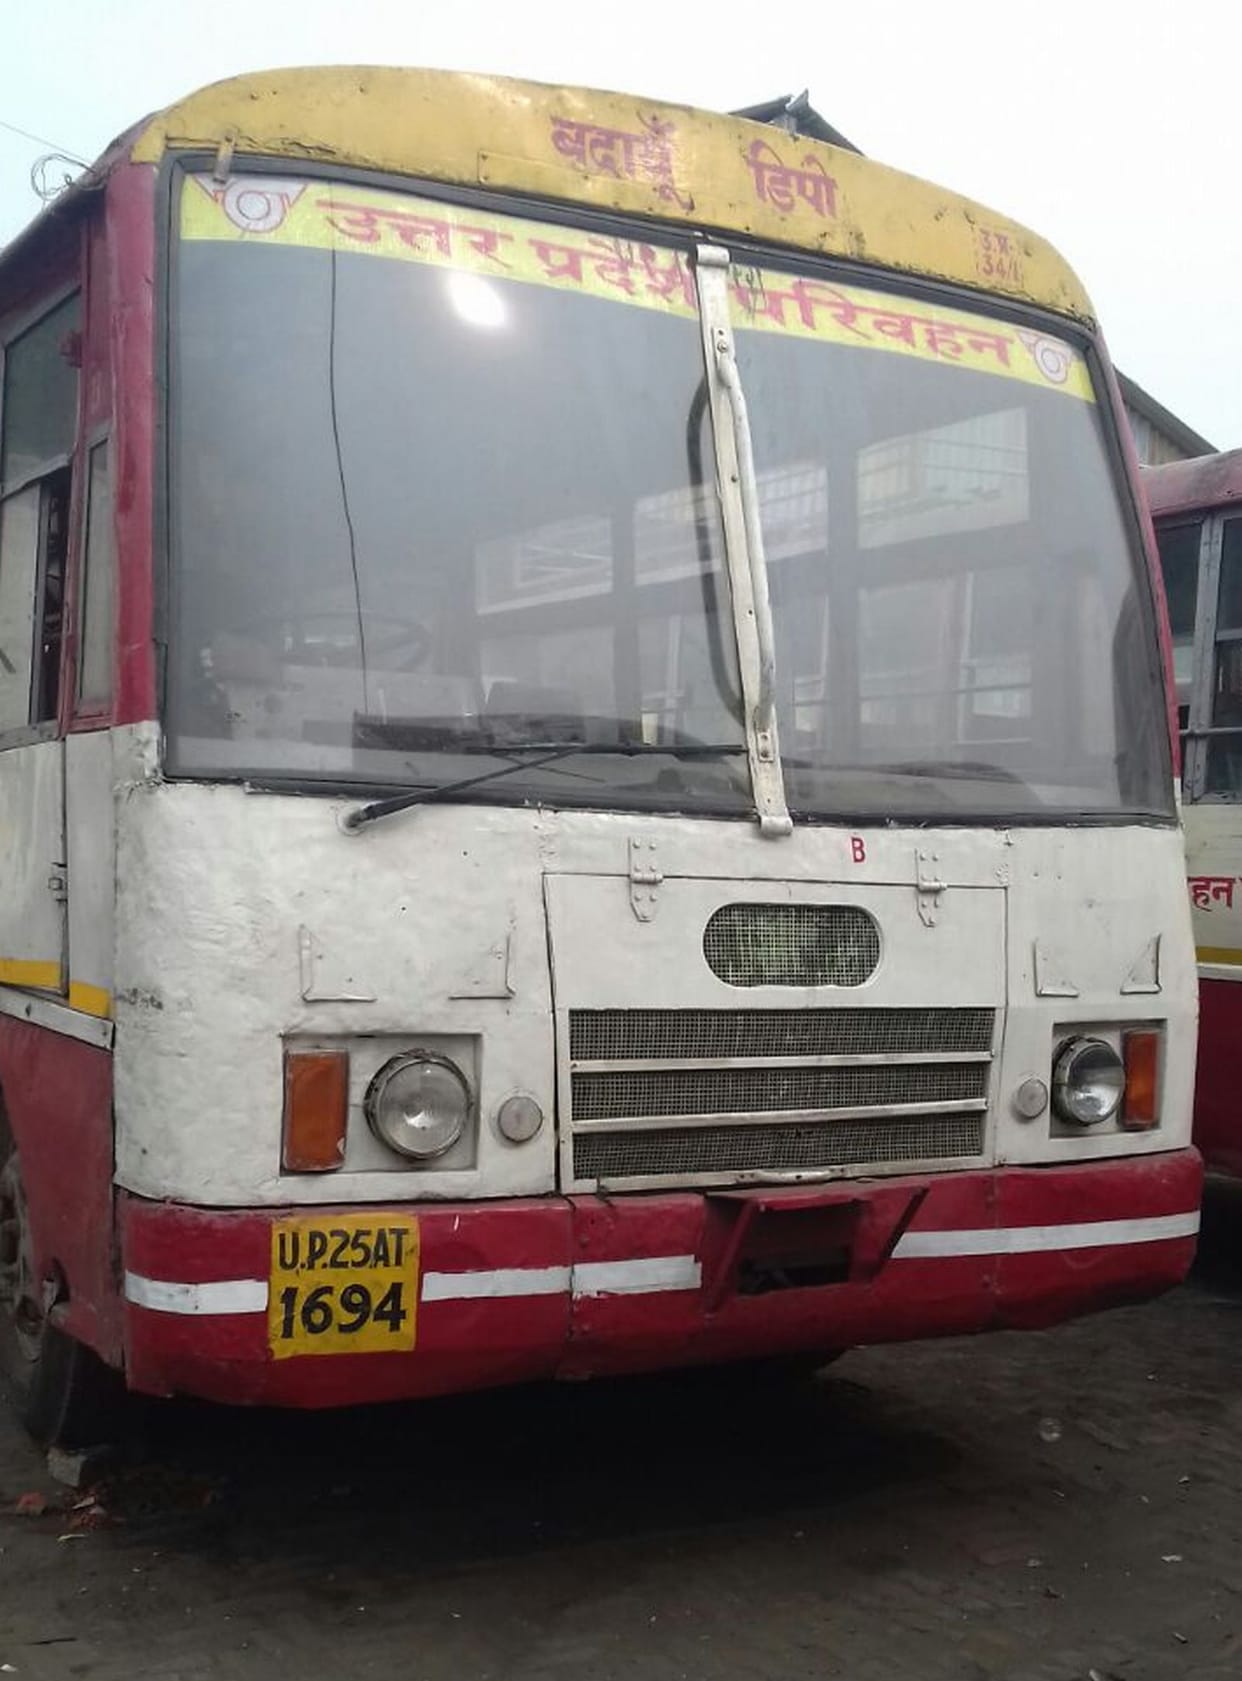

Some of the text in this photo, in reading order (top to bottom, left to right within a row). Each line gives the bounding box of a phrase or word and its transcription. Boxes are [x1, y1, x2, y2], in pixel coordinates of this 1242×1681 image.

[315, 201, 516, 270] उत्तर
[728, 279, 1014, 368] परिवहन
[851, 836, 866, 863] B
[1187, 876, 1236, 912] हन
[280, 1282, 407, 1339] 1694
